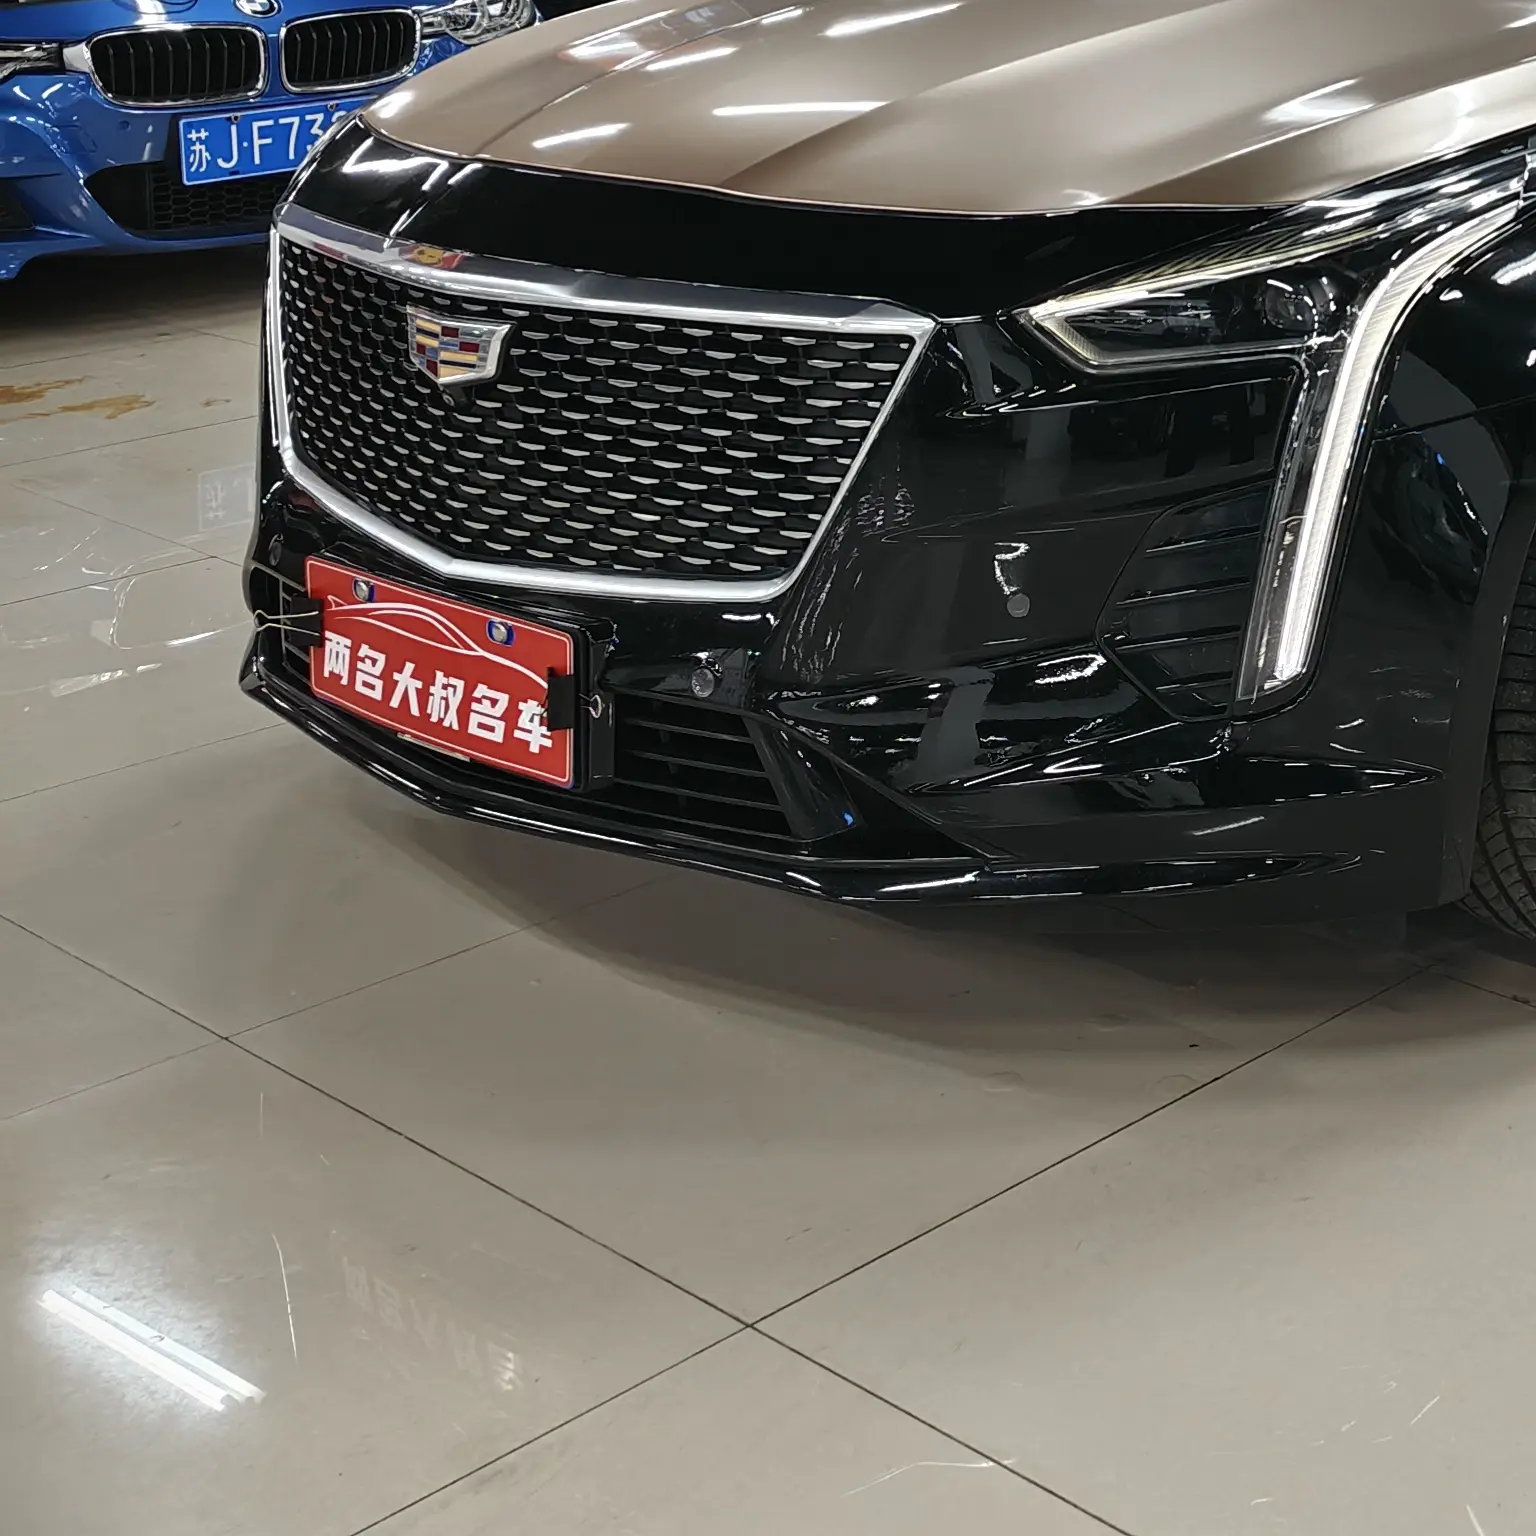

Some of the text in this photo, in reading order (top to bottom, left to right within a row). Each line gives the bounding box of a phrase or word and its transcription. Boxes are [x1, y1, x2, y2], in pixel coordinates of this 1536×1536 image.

[187, 111, 347, 173] 苏J·F73
[323, 630, 553, 754] 两名大叔名车
